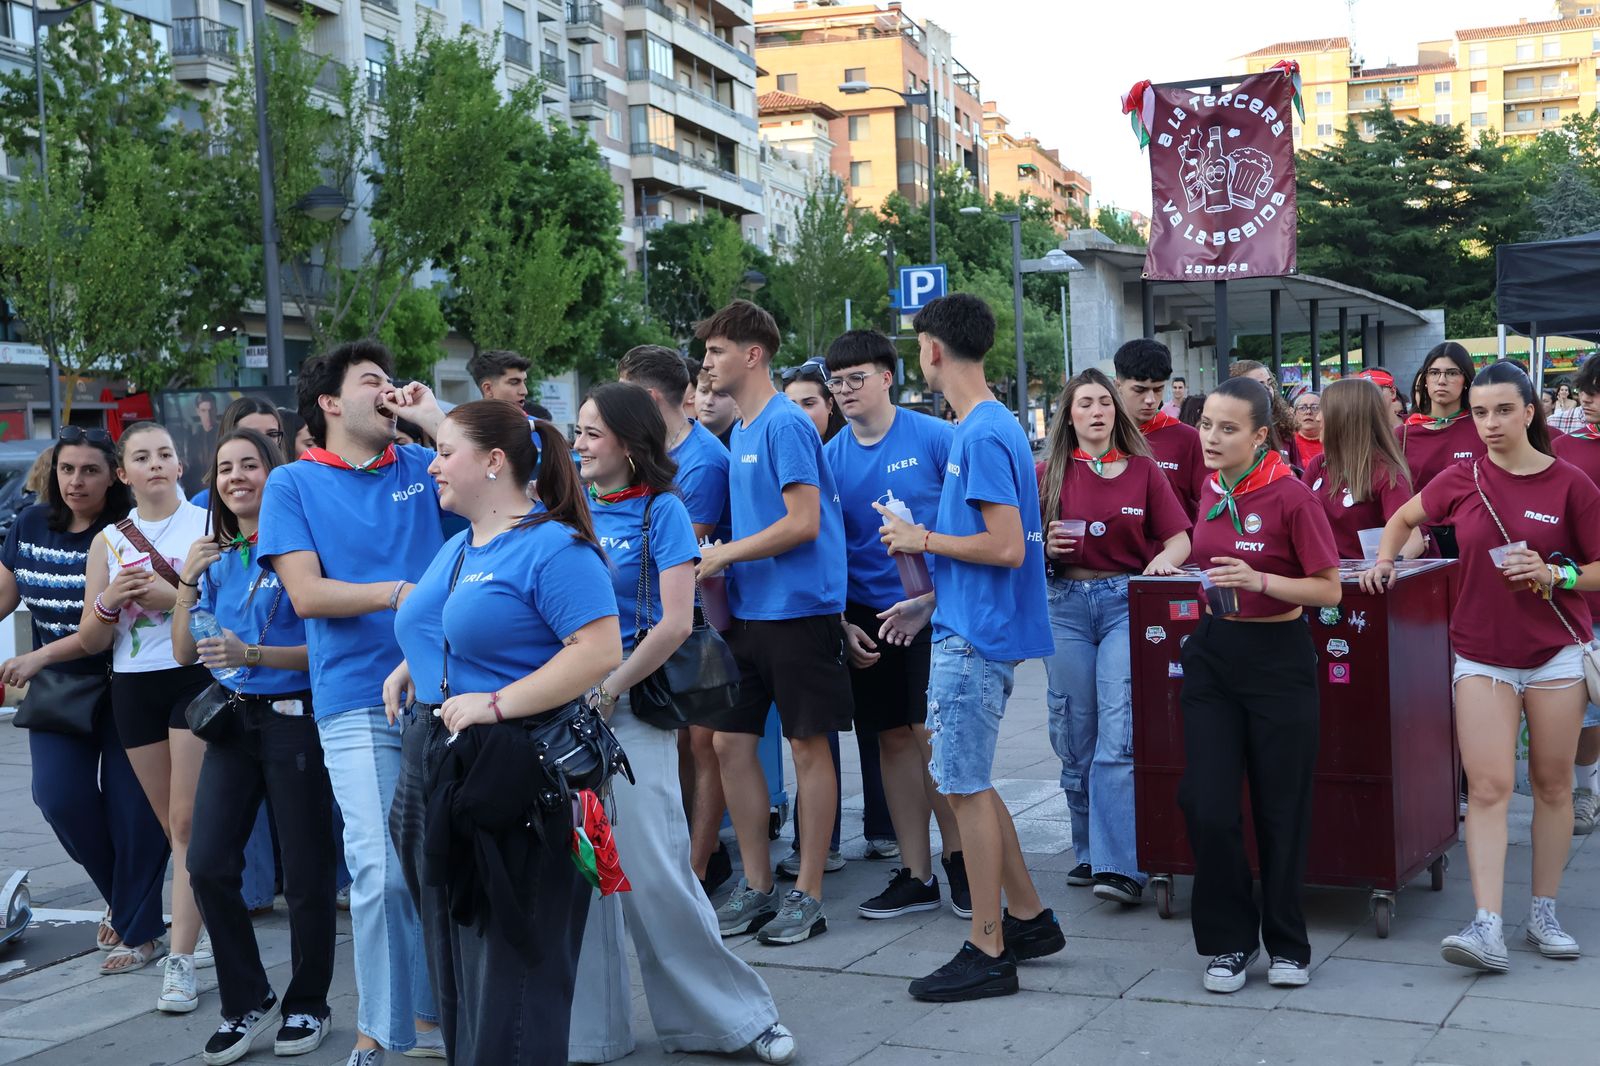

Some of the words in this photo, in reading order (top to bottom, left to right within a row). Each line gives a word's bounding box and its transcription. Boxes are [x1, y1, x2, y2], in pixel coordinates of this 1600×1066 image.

[910, 271, 935, 306] P
[887, 457, 918, 473] IKER
[1156, 461, 1179, 471] UCAS
[392, 482, 424, 502] HUGO
[599, 536, 631, 549] EVA
[1235, 541, 1265, 552] VICKY
[248, 576, 280, 592] LRA
